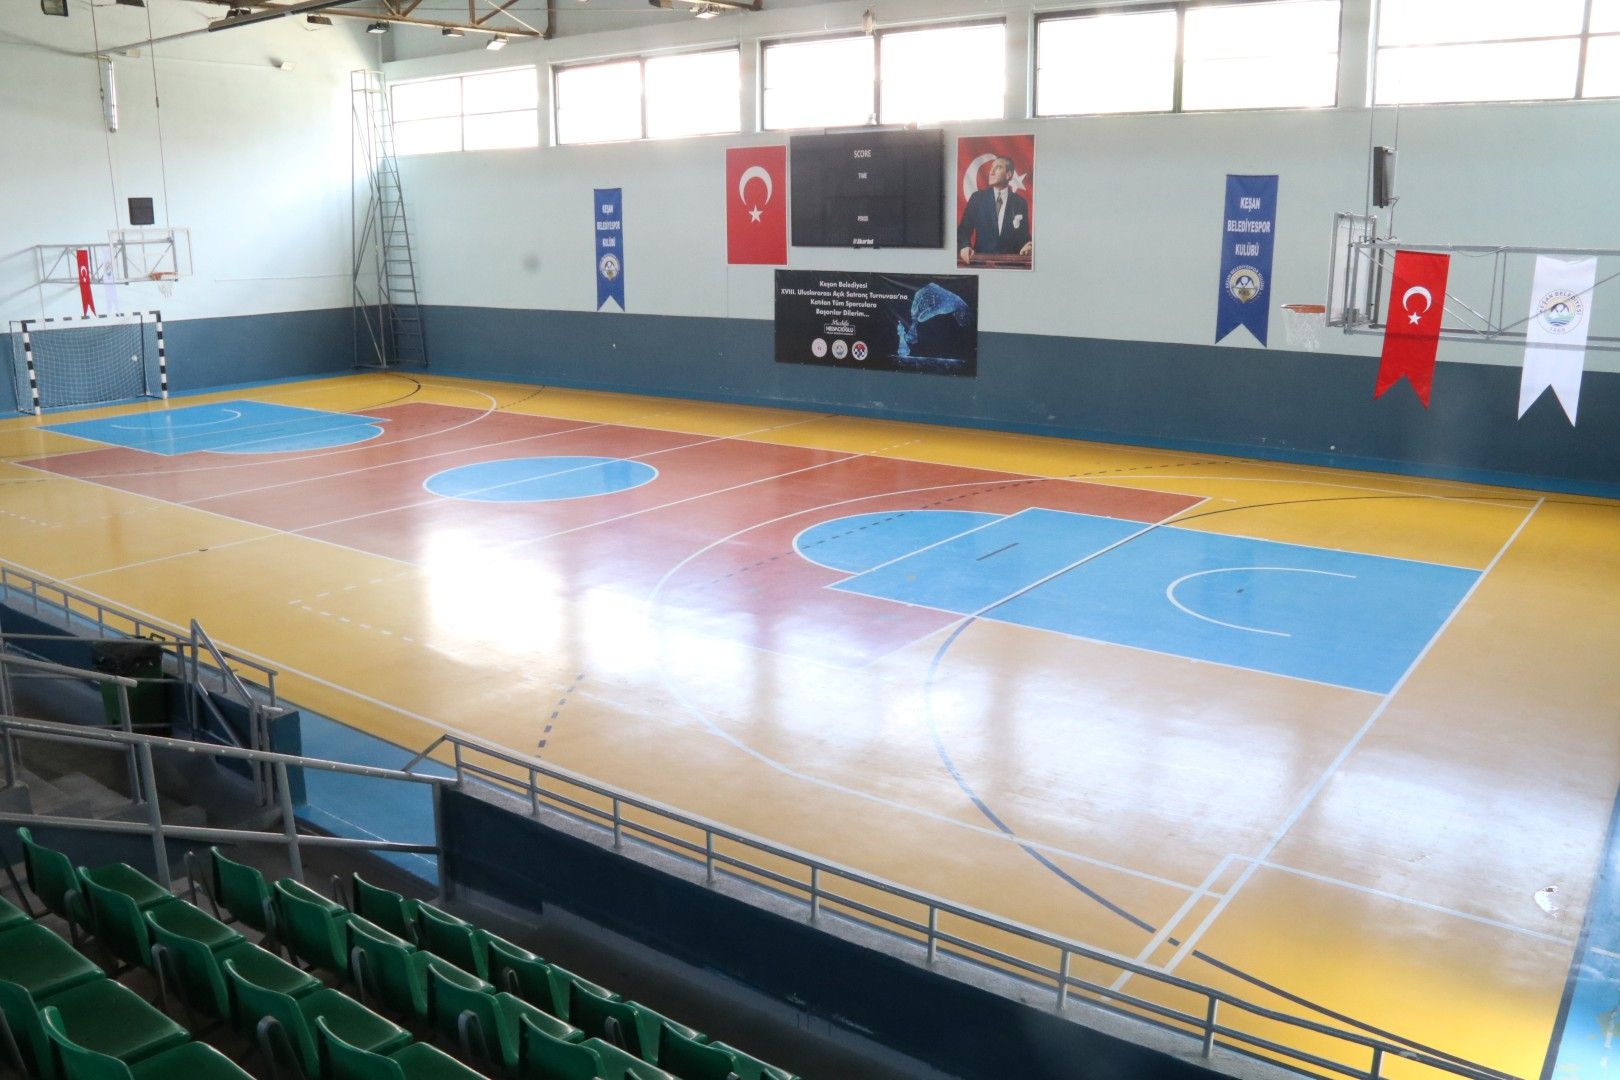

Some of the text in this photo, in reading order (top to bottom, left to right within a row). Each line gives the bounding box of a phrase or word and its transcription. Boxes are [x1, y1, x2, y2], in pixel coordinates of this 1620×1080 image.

[853, 149, 872, 158] SCORE
[1240, 197, 1261, 212] KEŞAN
[1227, 219, 1271, 233] BELEDİYESPOR
[1235, 242, 1260, 256] KULÜBÜ
[819, 281, 868, 289] Keşan Belediyesi
[832, 290, 845, 298] Açık
[846, 291, 869, 299] Satranç
[845, 300, 877, 308] Sporculara
